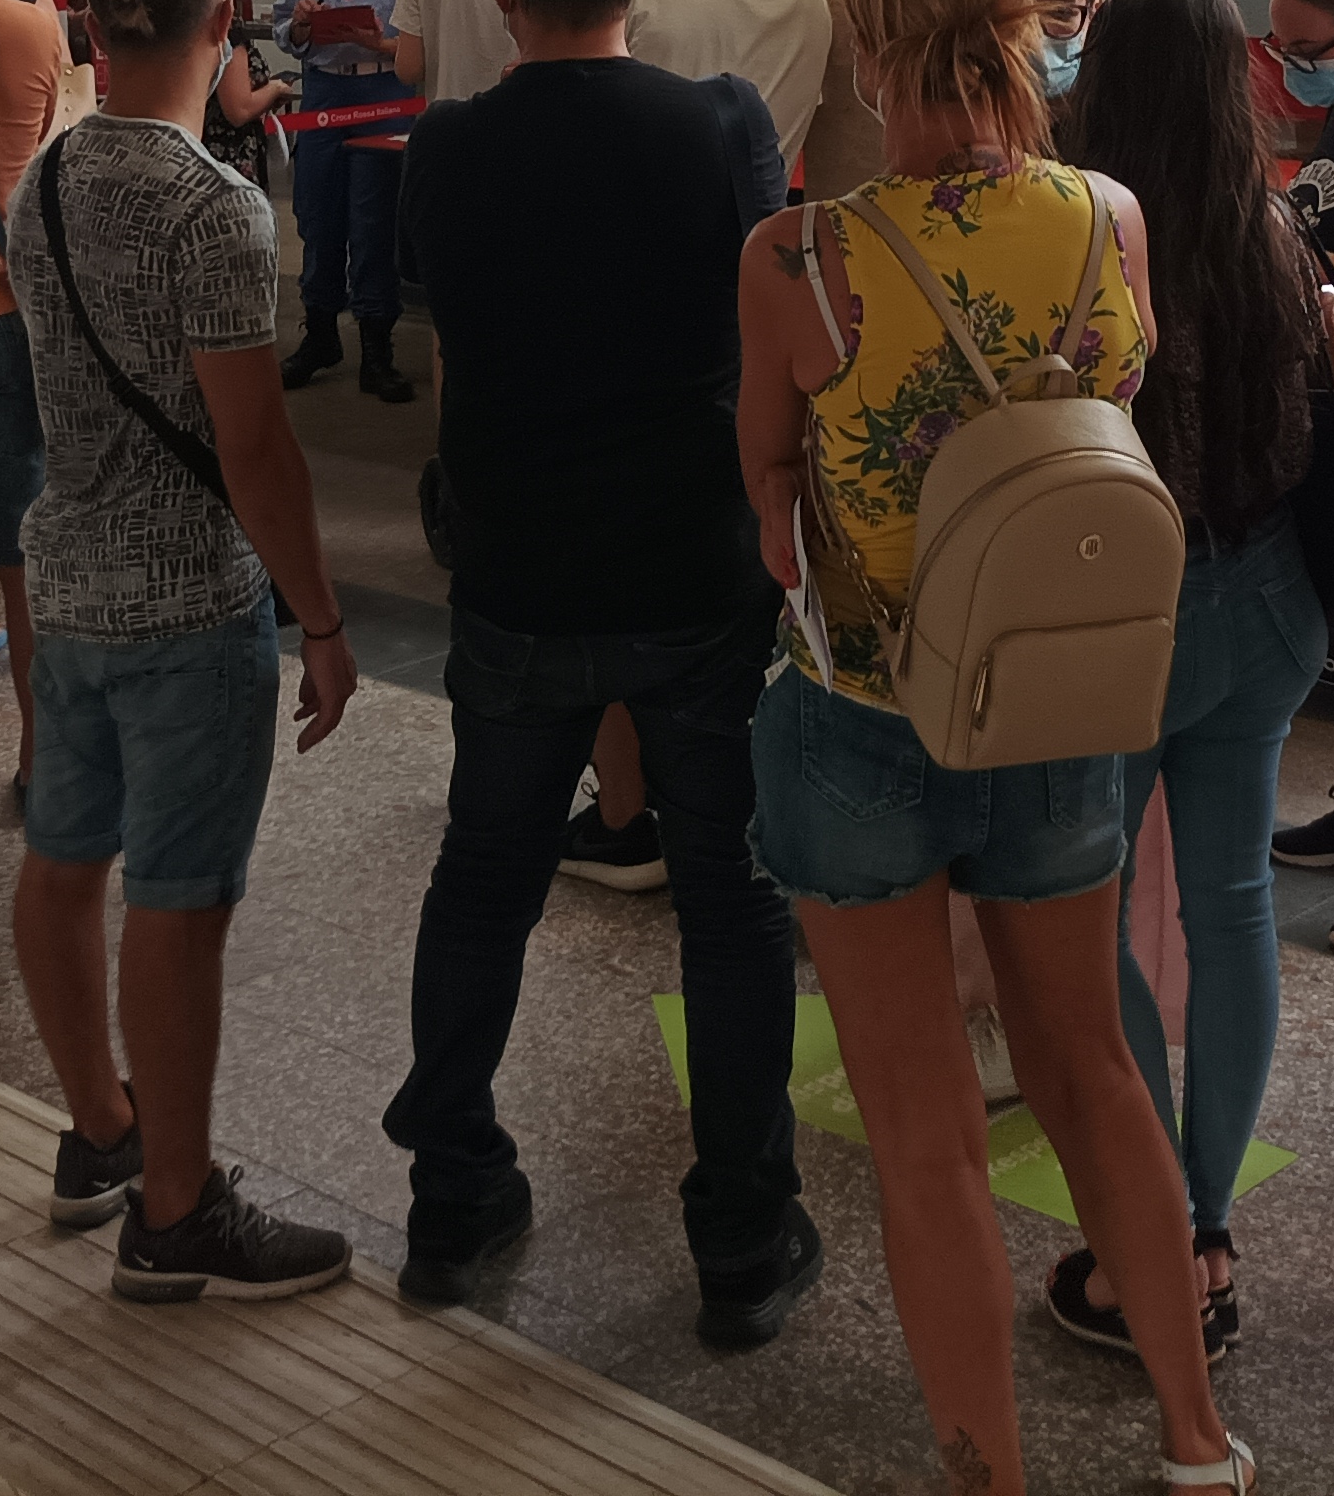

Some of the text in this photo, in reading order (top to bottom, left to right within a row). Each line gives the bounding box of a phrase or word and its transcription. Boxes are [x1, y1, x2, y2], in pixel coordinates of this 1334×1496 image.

[330, 106, 401, 123] Croce Rossa Italiana
